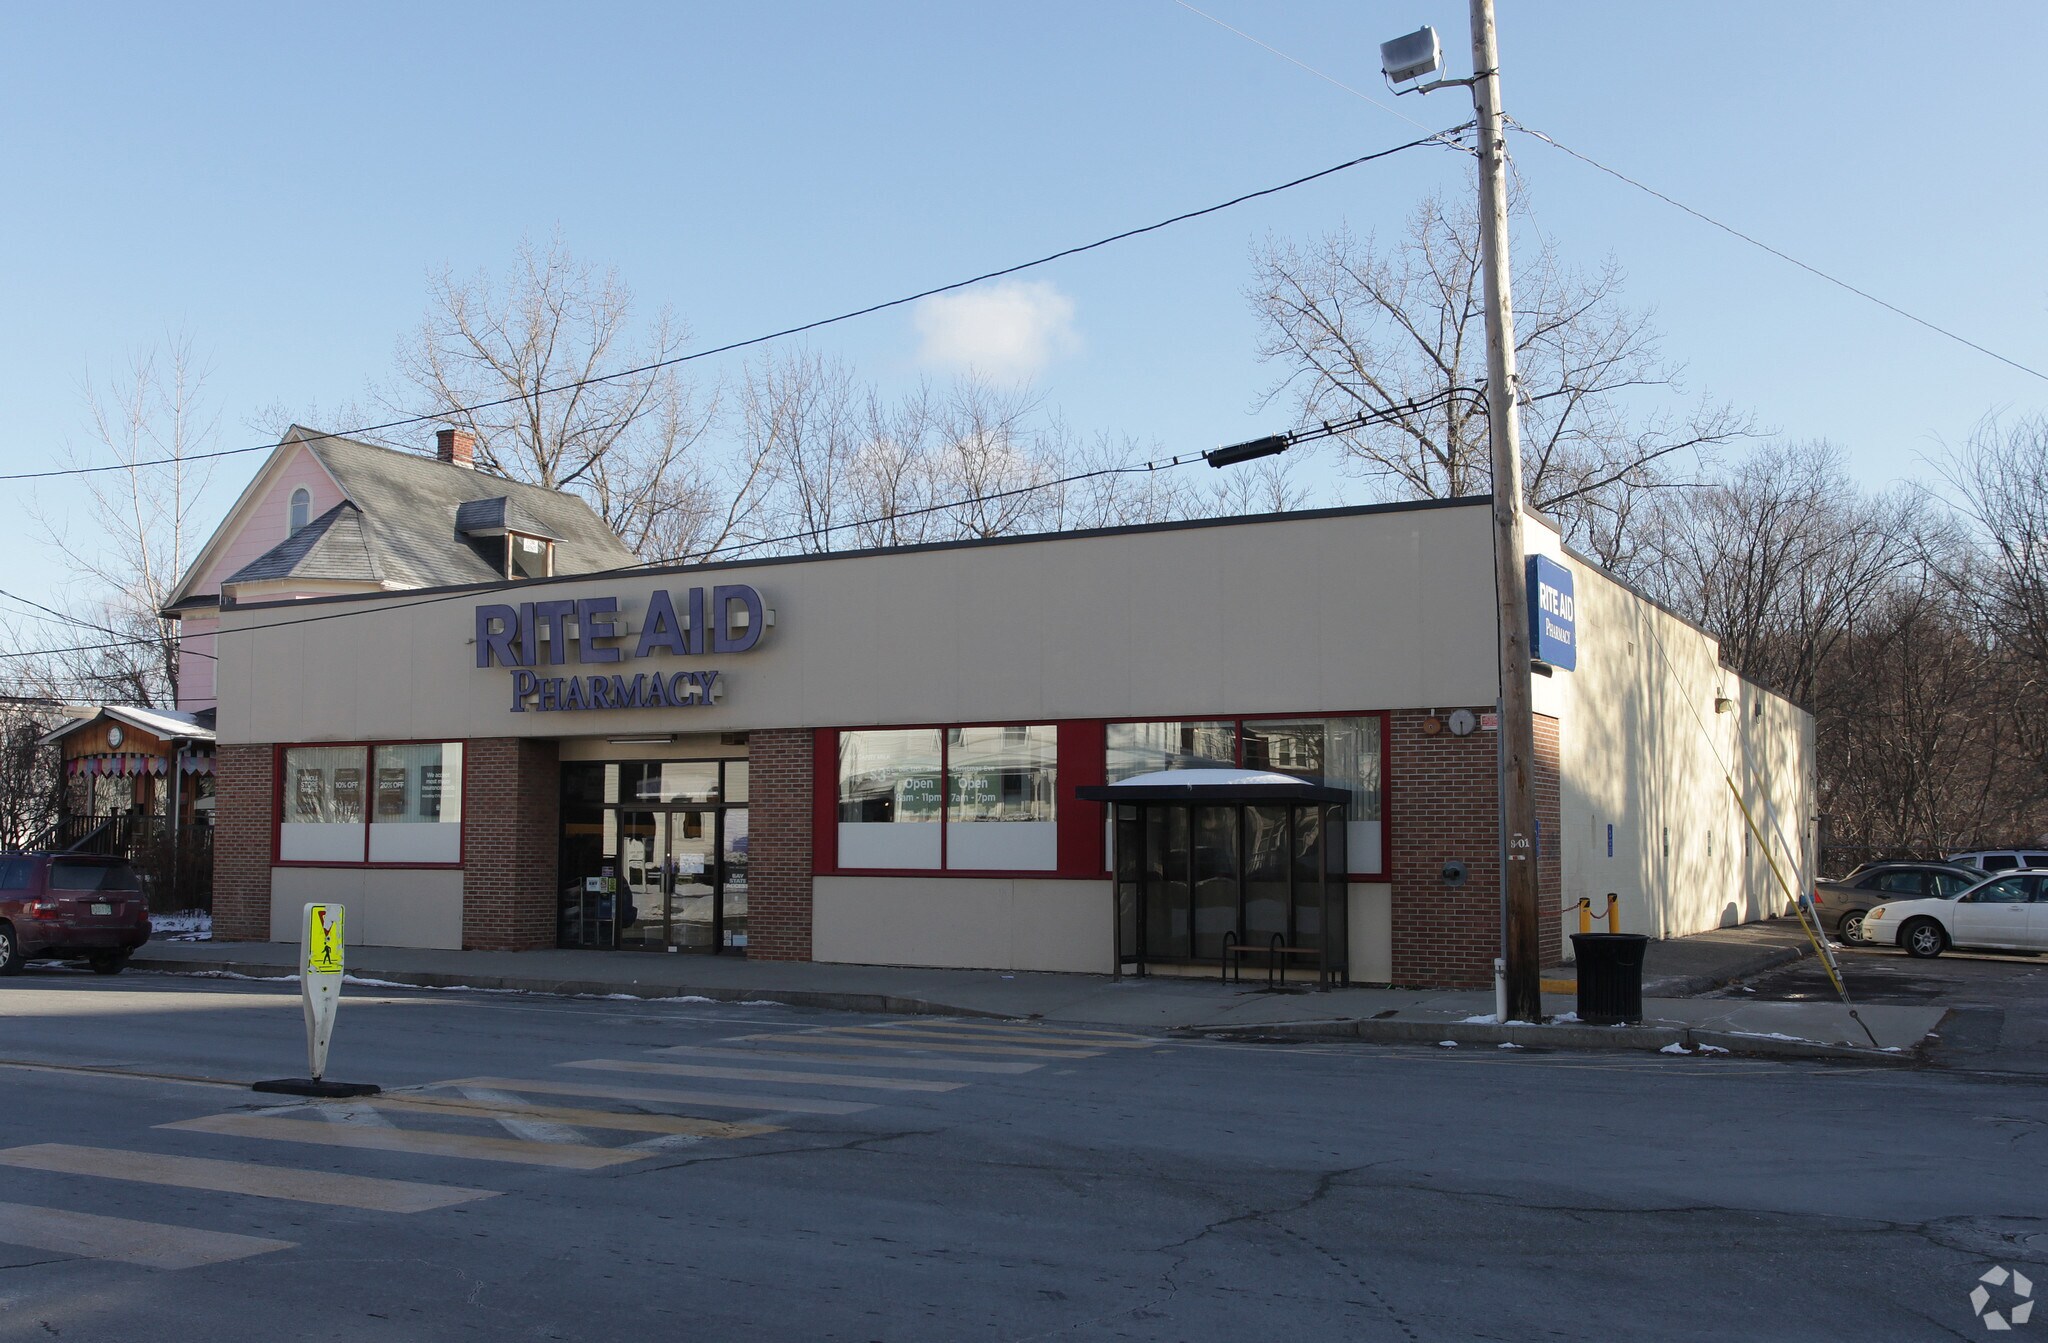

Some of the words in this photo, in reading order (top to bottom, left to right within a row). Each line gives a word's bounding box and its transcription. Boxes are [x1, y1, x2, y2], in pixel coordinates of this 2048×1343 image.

[1539, 582, 1559, 616] RITE
[1559, 593, 1574, 622] AID
[475, 596, 622, 668] RITE
[635, 584, 765, 658] AID
[510, 669, 719, 713] PHARMACY
[335, 781, 346, 789] 10%
[379, 781, 393, 789] 20%
[393, 781, 405, 789] OFF
[904, 778, 934, 791] Open
[958, 777, 988, 791] Open
[895, 793, 914, 802] 8am
[921, 793, 942, 803] 11pm
[950, 793, 969, 802] 7am
[976, 793, 996, 804] 7pm
